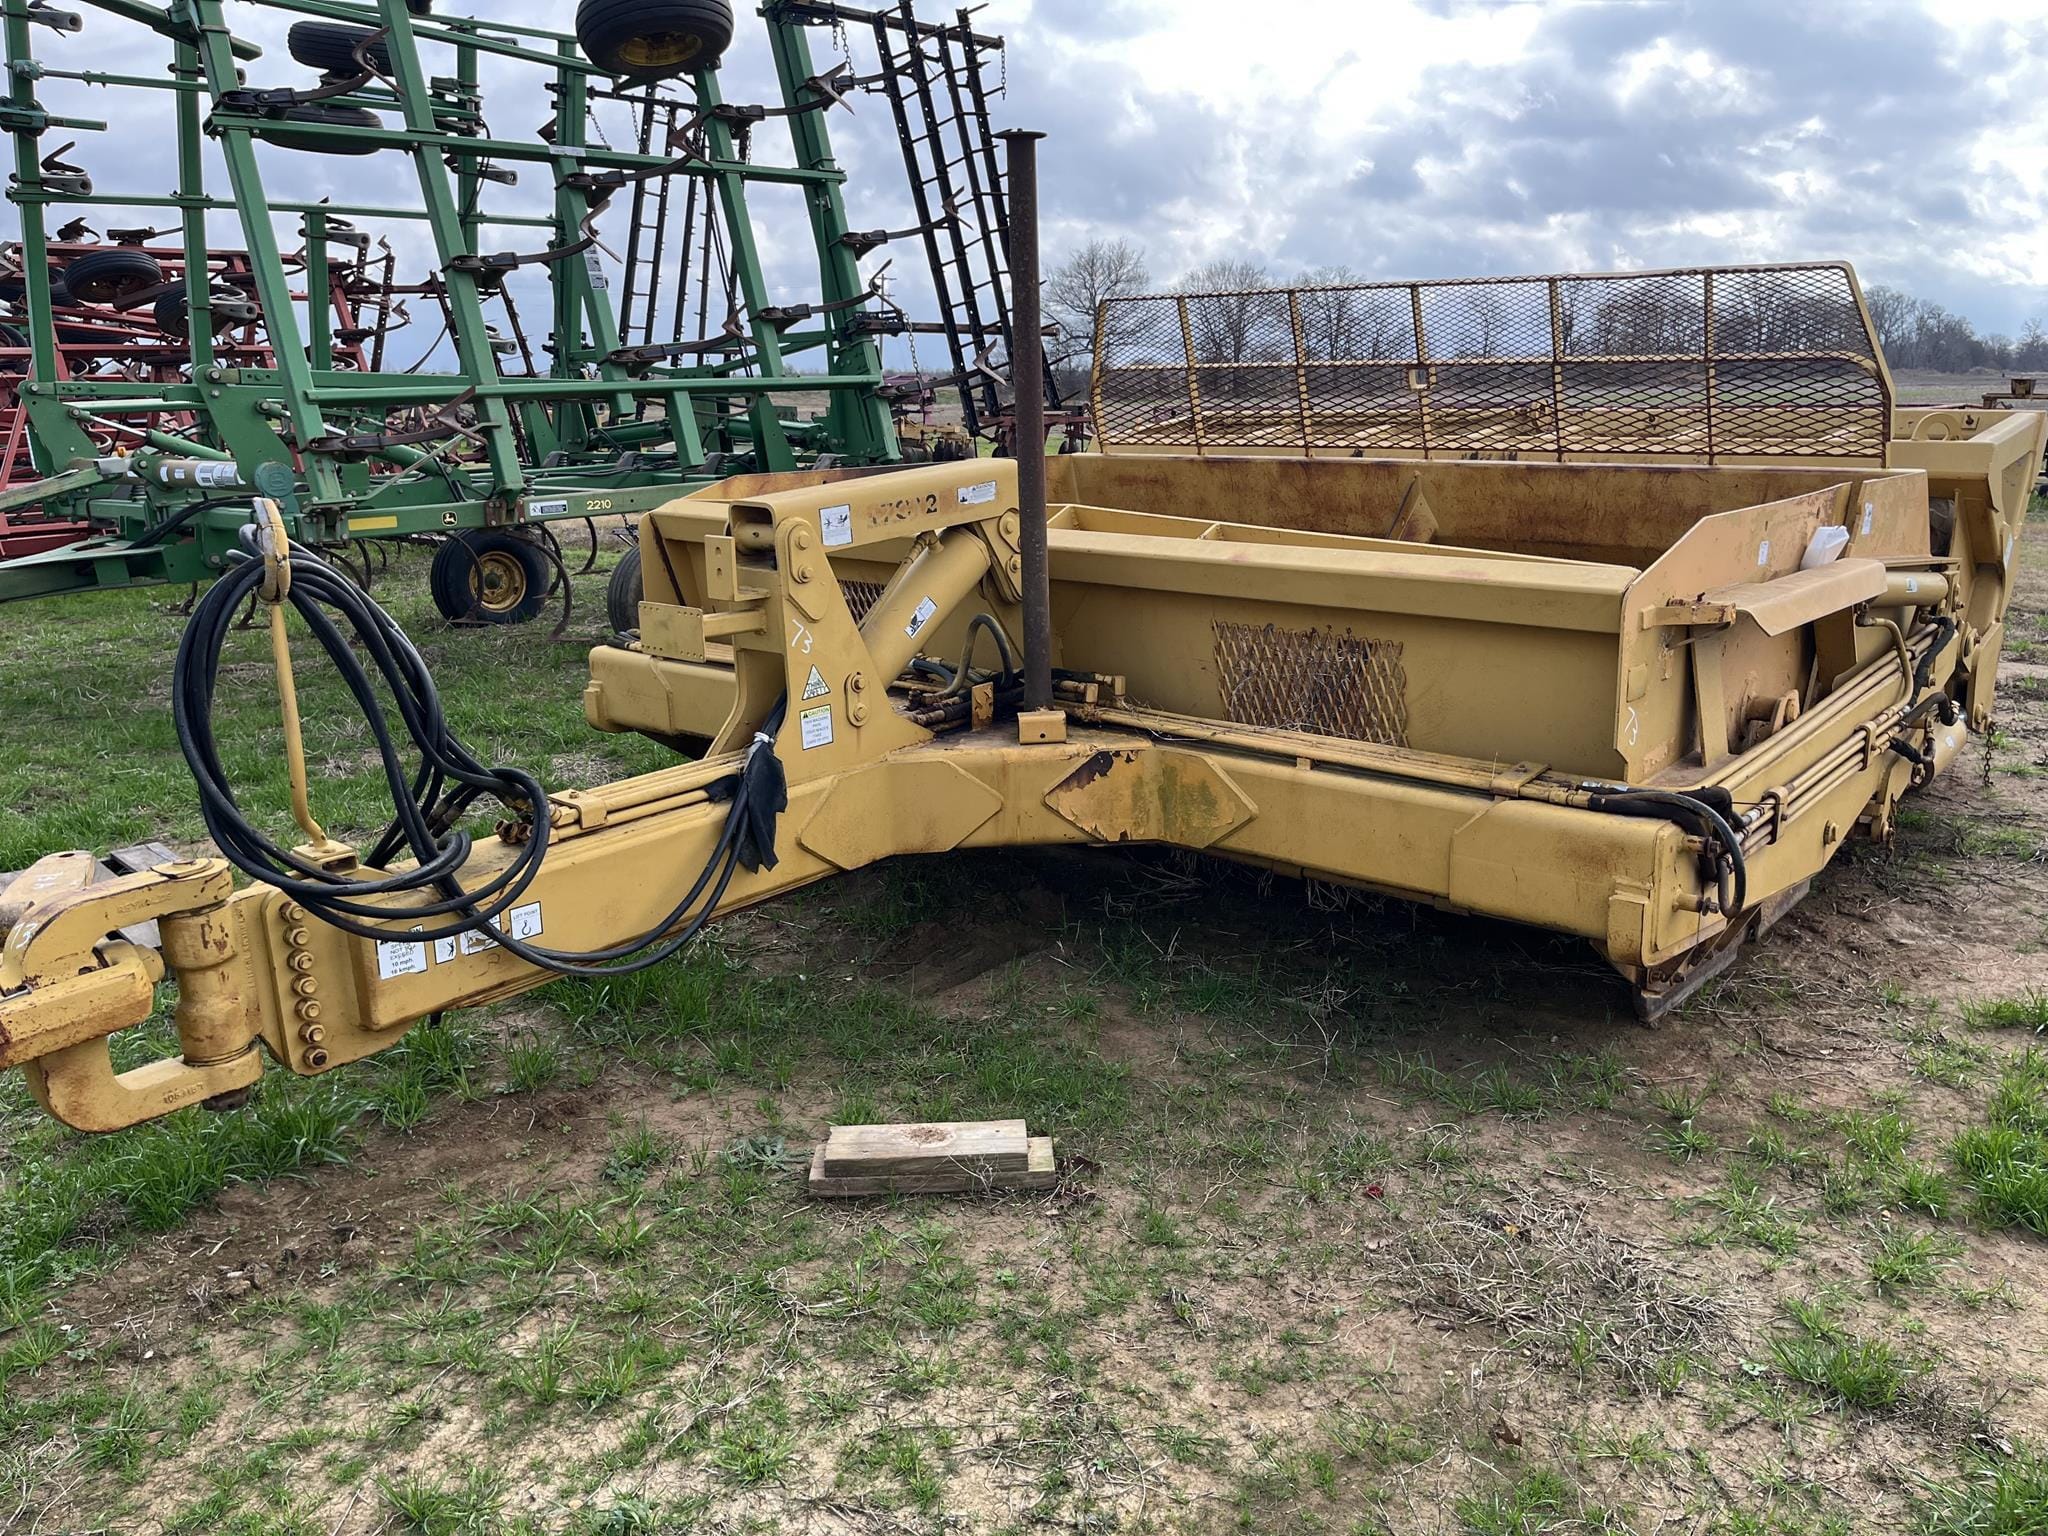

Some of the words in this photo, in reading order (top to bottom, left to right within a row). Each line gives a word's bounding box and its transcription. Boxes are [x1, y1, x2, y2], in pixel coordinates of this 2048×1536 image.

[586, 499, 612, 510] 2210
[792, 619, 813, 654] 73
[808, 707, 829, 717] CAUTION
[1624, 706, 1639, 746] 73
[10, 921, 40, 951] 73
